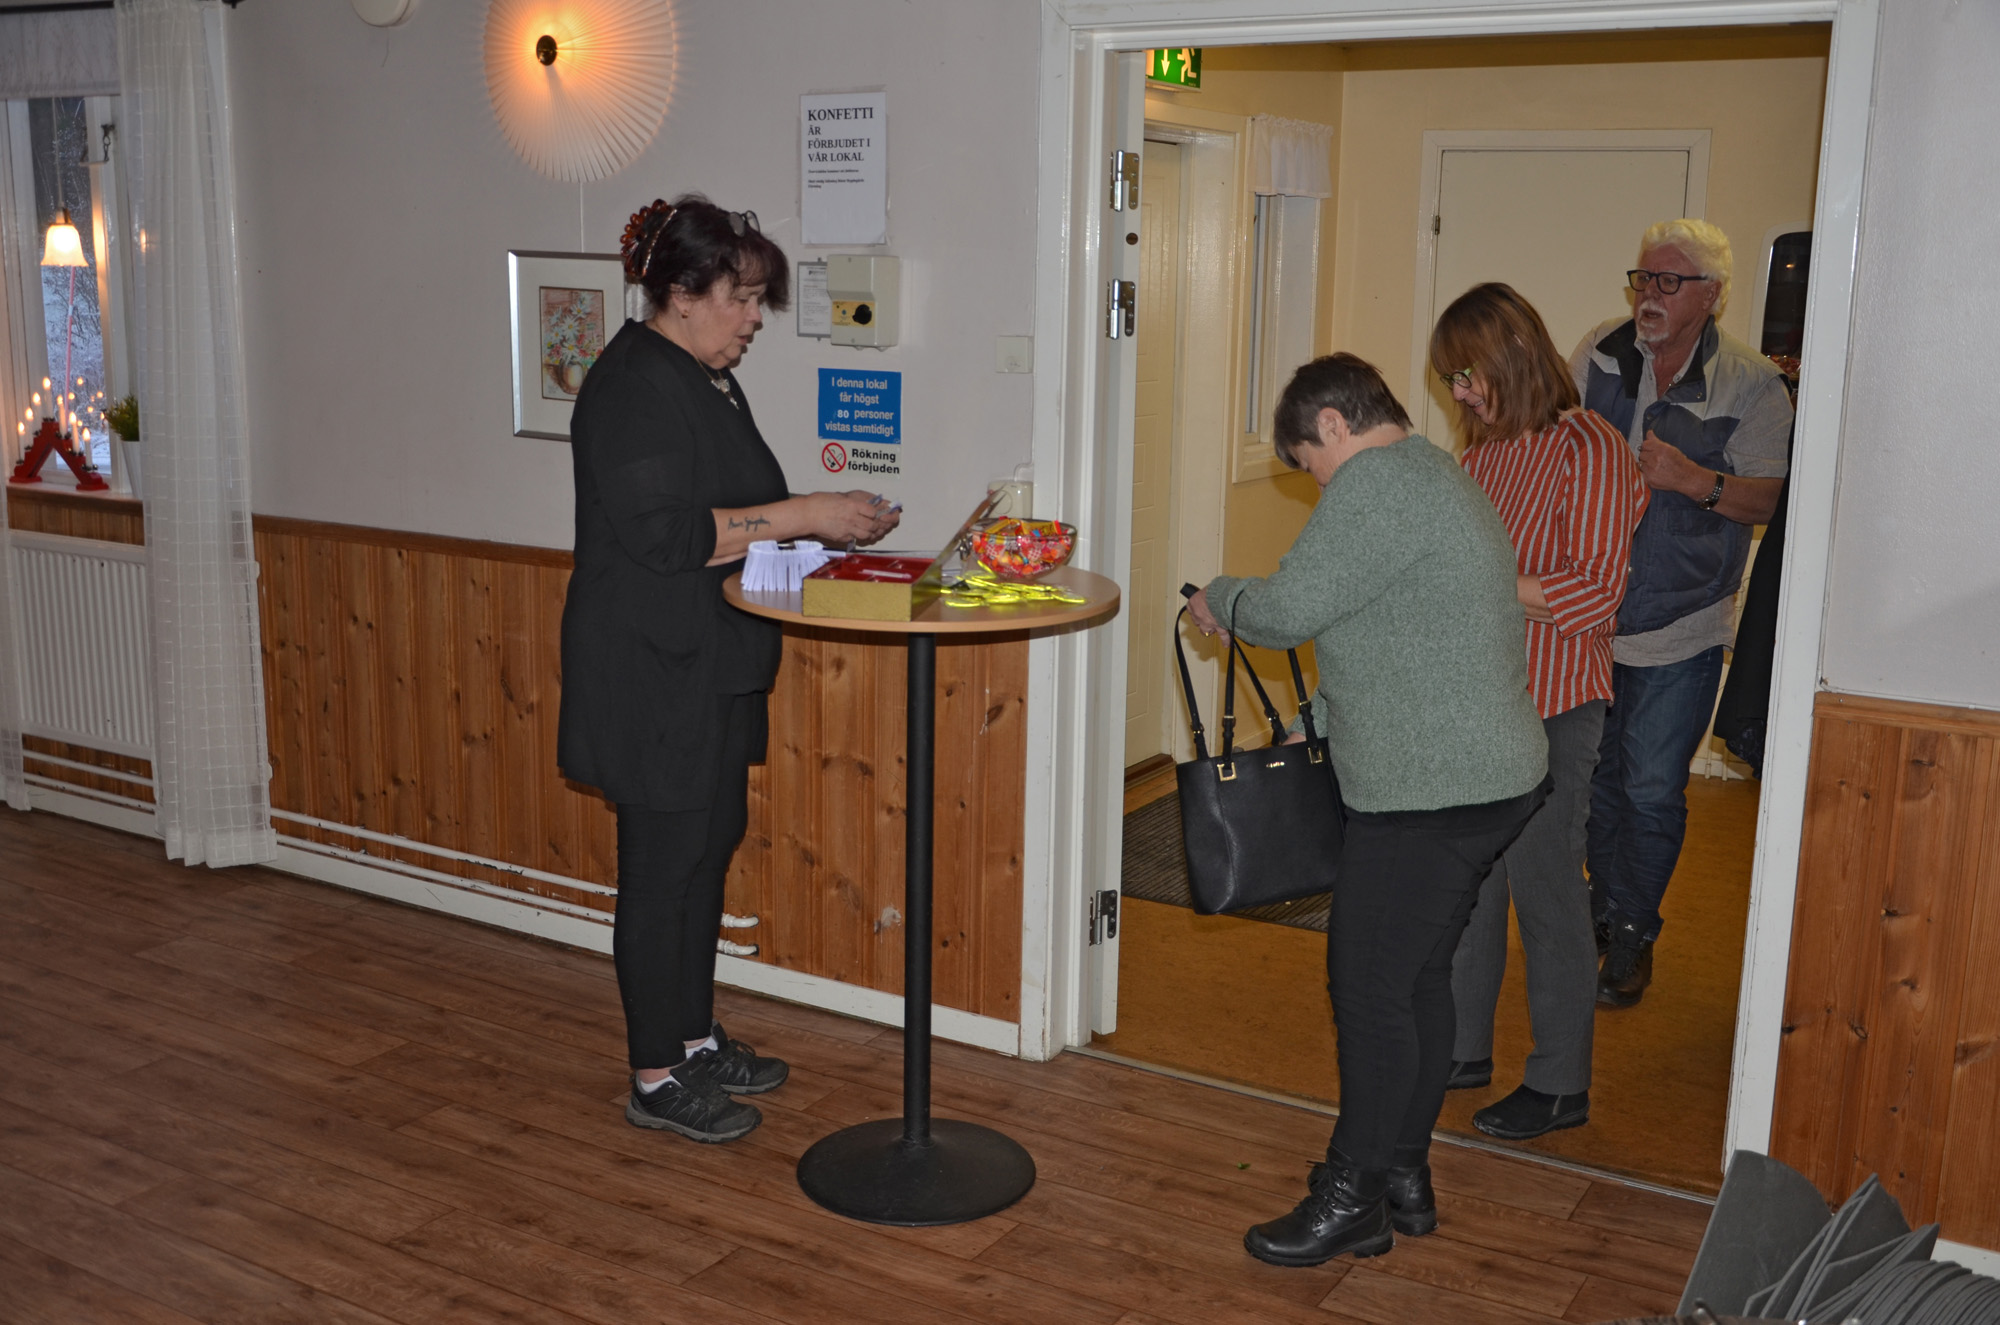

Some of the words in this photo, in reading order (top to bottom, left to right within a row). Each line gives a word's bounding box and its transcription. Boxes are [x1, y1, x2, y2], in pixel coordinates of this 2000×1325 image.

[808, 107, 873, 121] KONFETTI
[808, 125, 821, 135] ÄR
[808, 138, 864, 149] FÖRBJUDET
[867, 138, 870, 147] I
[808, 152, 828, 162] VÅR
[830, 152, 864, 162] LOKAL
[831, 377, 835, 387] I
[837, 377, 864, 388] denna
[866, 379, 888, 390] lokal
[839, 392, 852, 403] får
[854, 393, 879, 406] högst
[837, 409, 850, 418] 80
[854, 410, 894, 420] personer
[825, 421, 850, 432] vistas
[852, 424, 894, 437] samtidigt
[852, 448, 896, 463] Rökning
[848, 461, 900, 474] förbjuden
